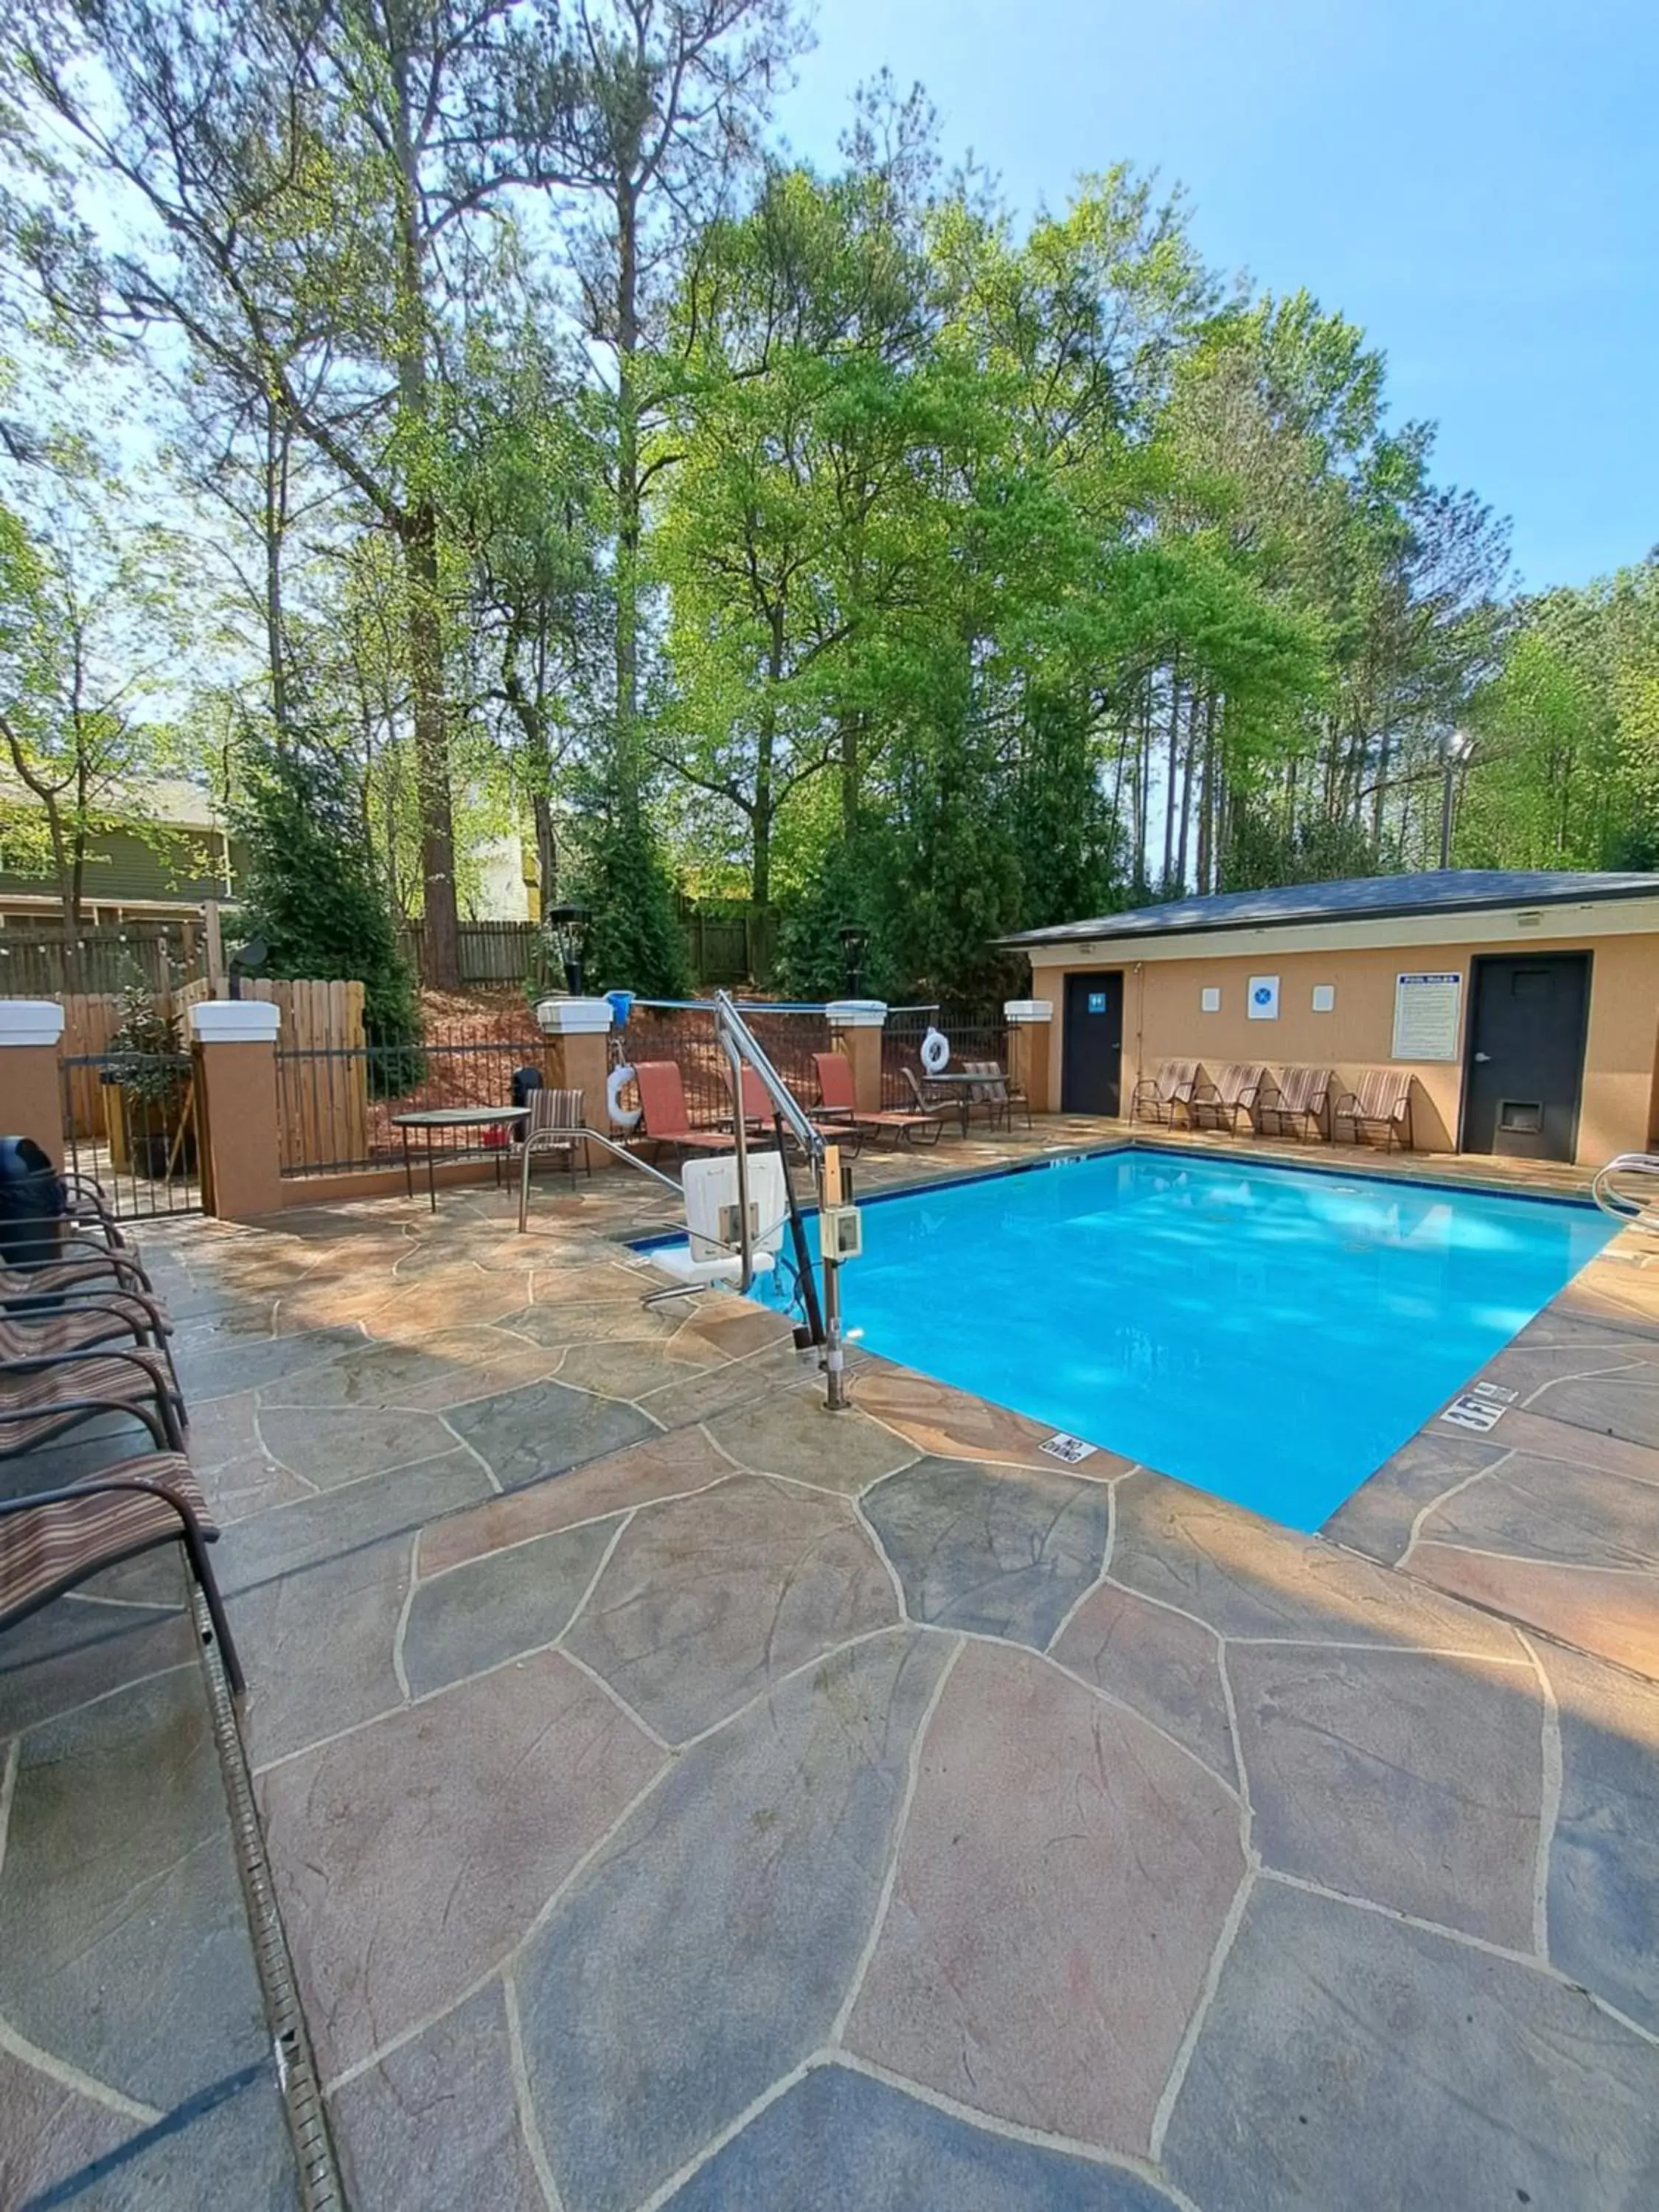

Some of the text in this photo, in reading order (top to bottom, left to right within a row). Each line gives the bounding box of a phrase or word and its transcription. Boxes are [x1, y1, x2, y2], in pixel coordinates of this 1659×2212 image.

[1447, 1411, 1489, 1427] 3
[1043, 1441, 1082, 1461] DIVING
[1065, 1439, 1083, 1450] NO
